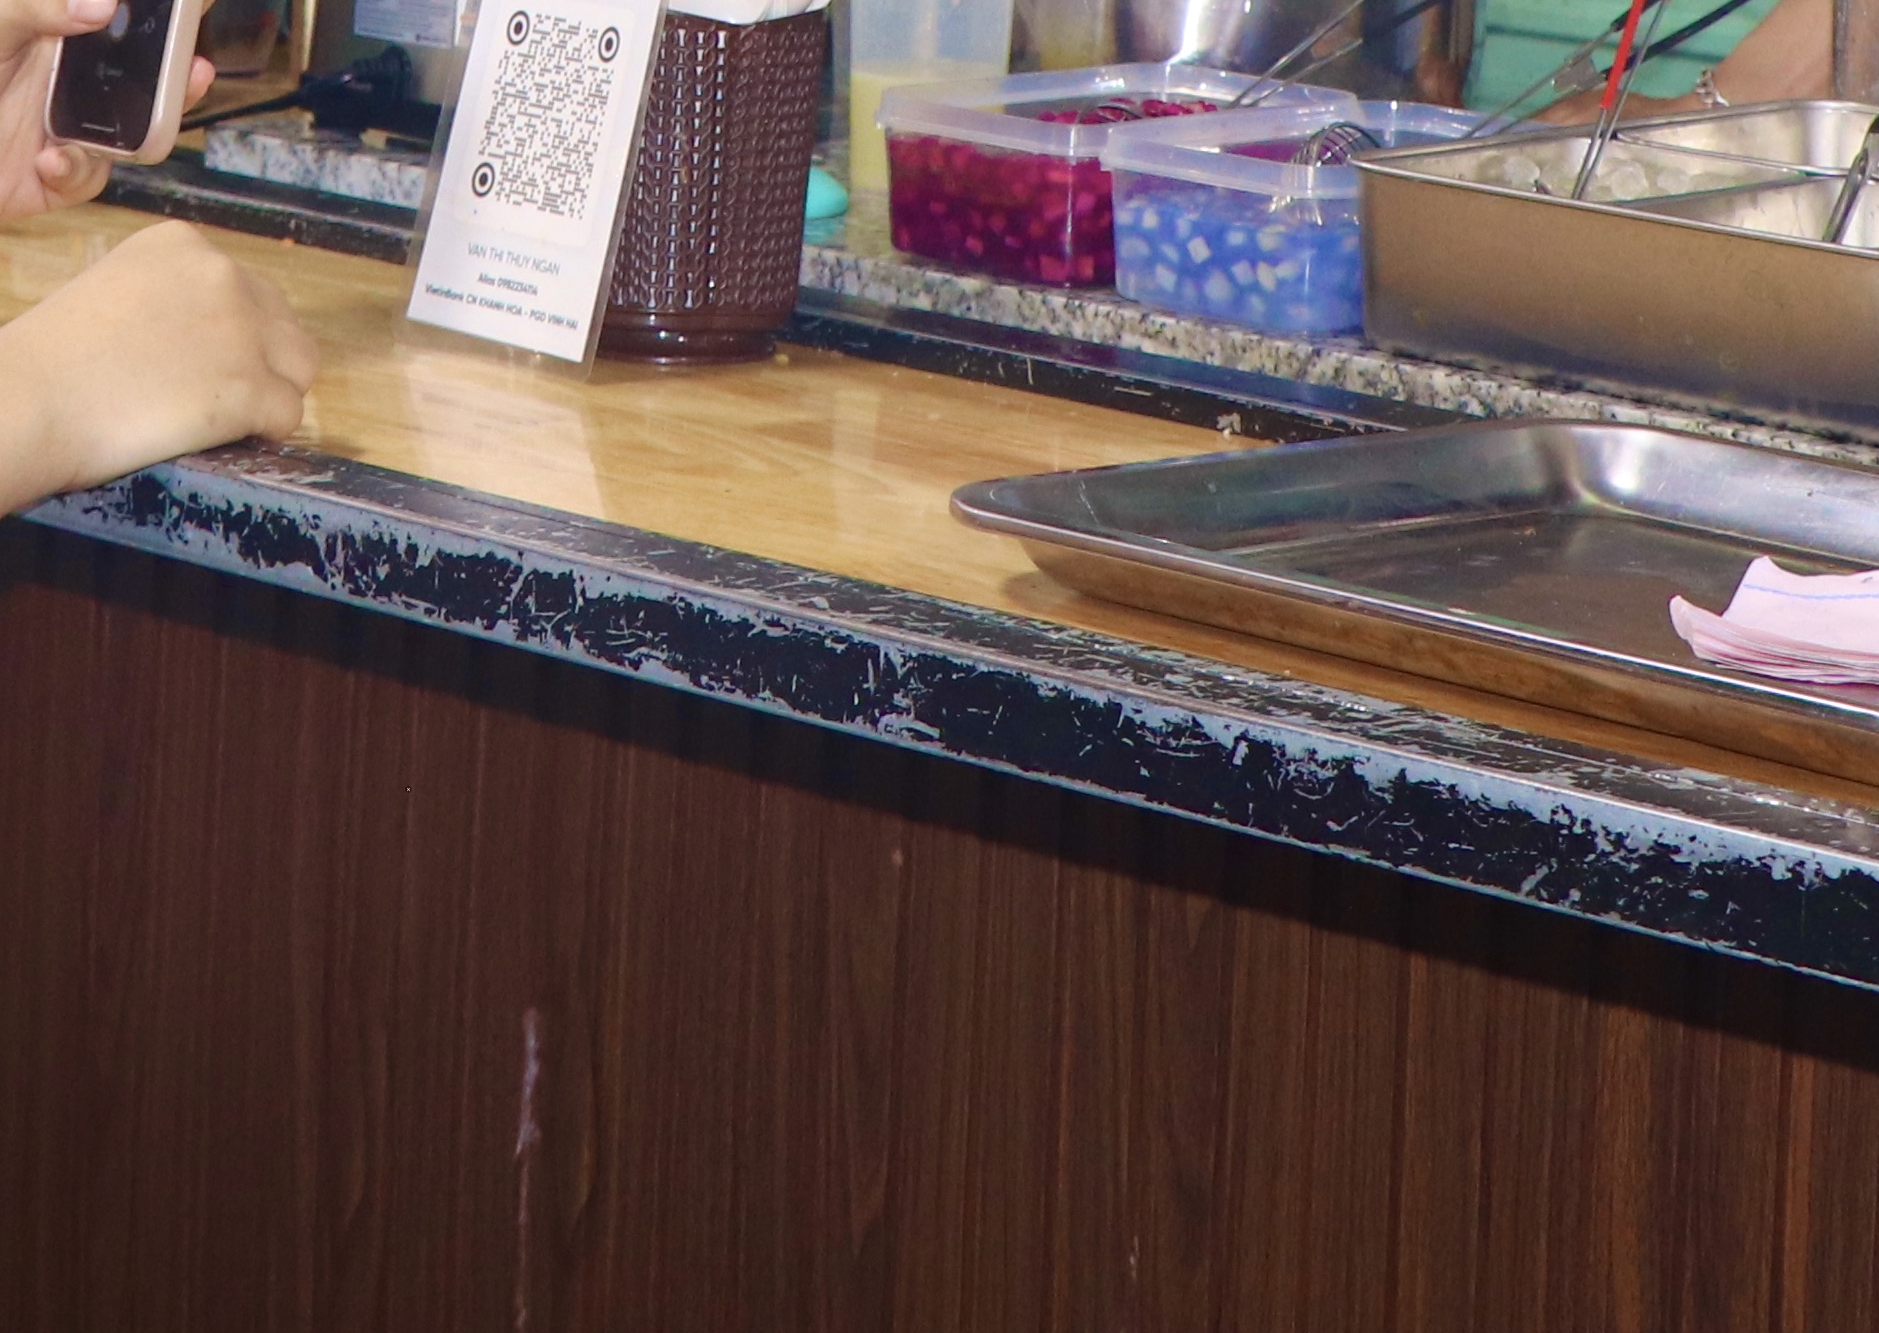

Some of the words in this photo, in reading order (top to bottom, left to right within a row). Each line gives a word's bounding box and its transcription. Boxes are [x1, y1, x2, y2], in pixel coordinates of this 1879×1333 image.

[468, 242, 487, 259] VAN
[489, 247, 504, 262] THI
[505, 250, 532, 268] THUY
[531, 258, 561, 276] NGAN
